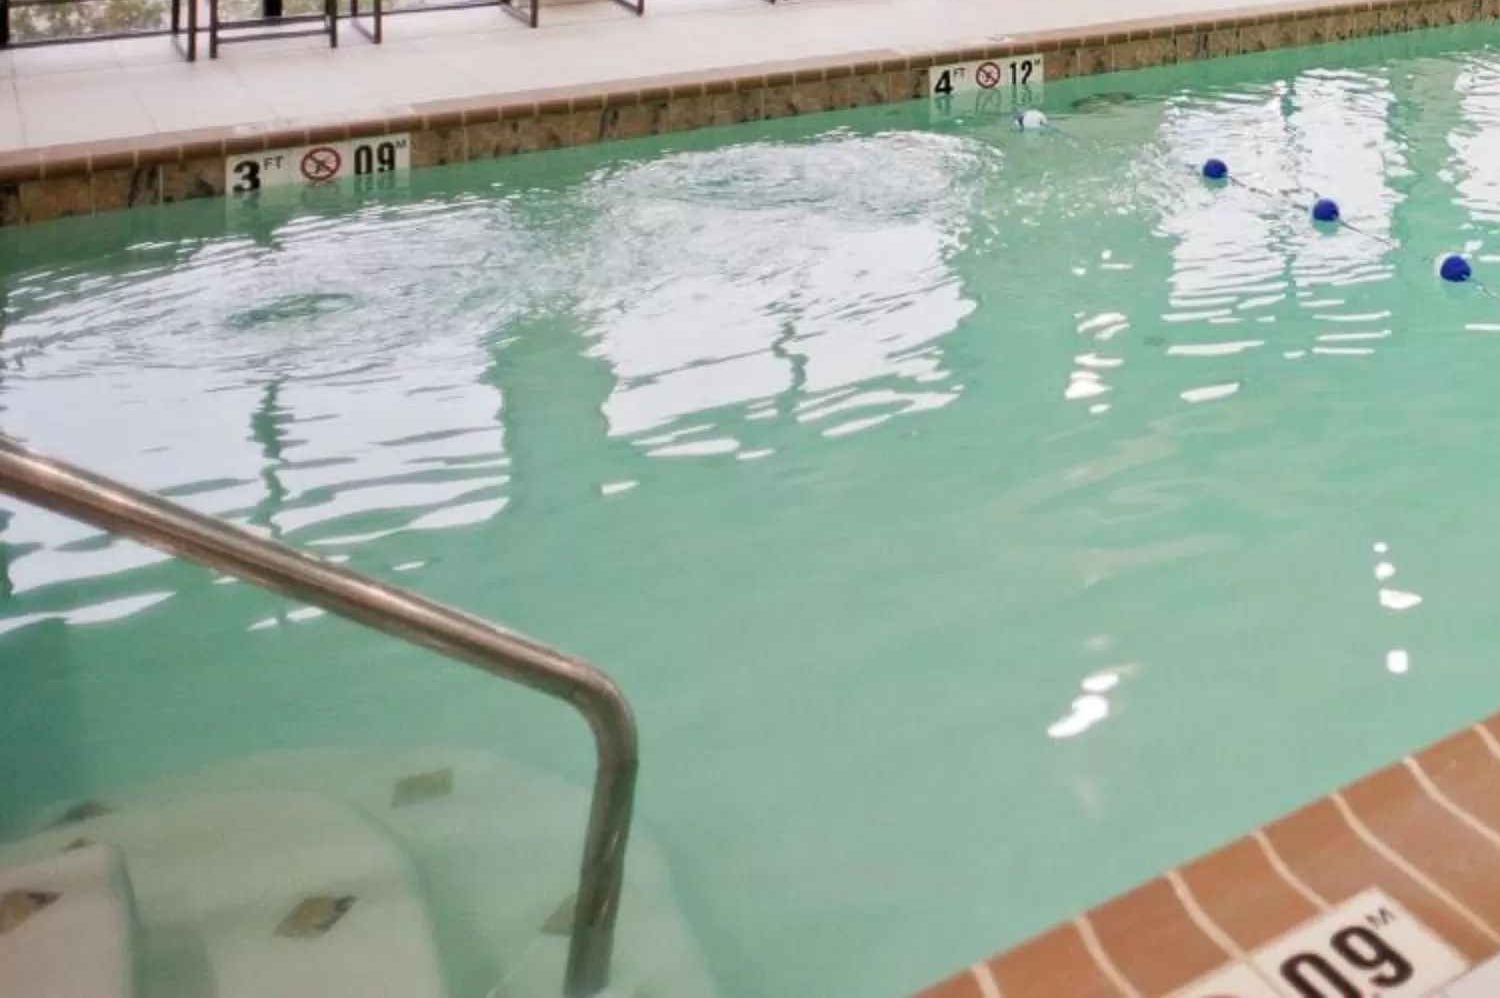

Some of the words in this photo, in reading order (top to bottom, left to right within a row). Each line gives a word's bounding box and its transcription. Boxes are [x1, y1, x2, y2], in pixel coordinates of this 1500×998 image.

[934, 69, 953, 95] 4
[1010, 60, 1033, 85] 12
[232, 160, 261, 193] 3
[263, 155, 285, 171] FT
[354, 142, 396, 176] 09
[1279, 924, 1414, 998] 09
[1363, 906, 1397, 931] M
